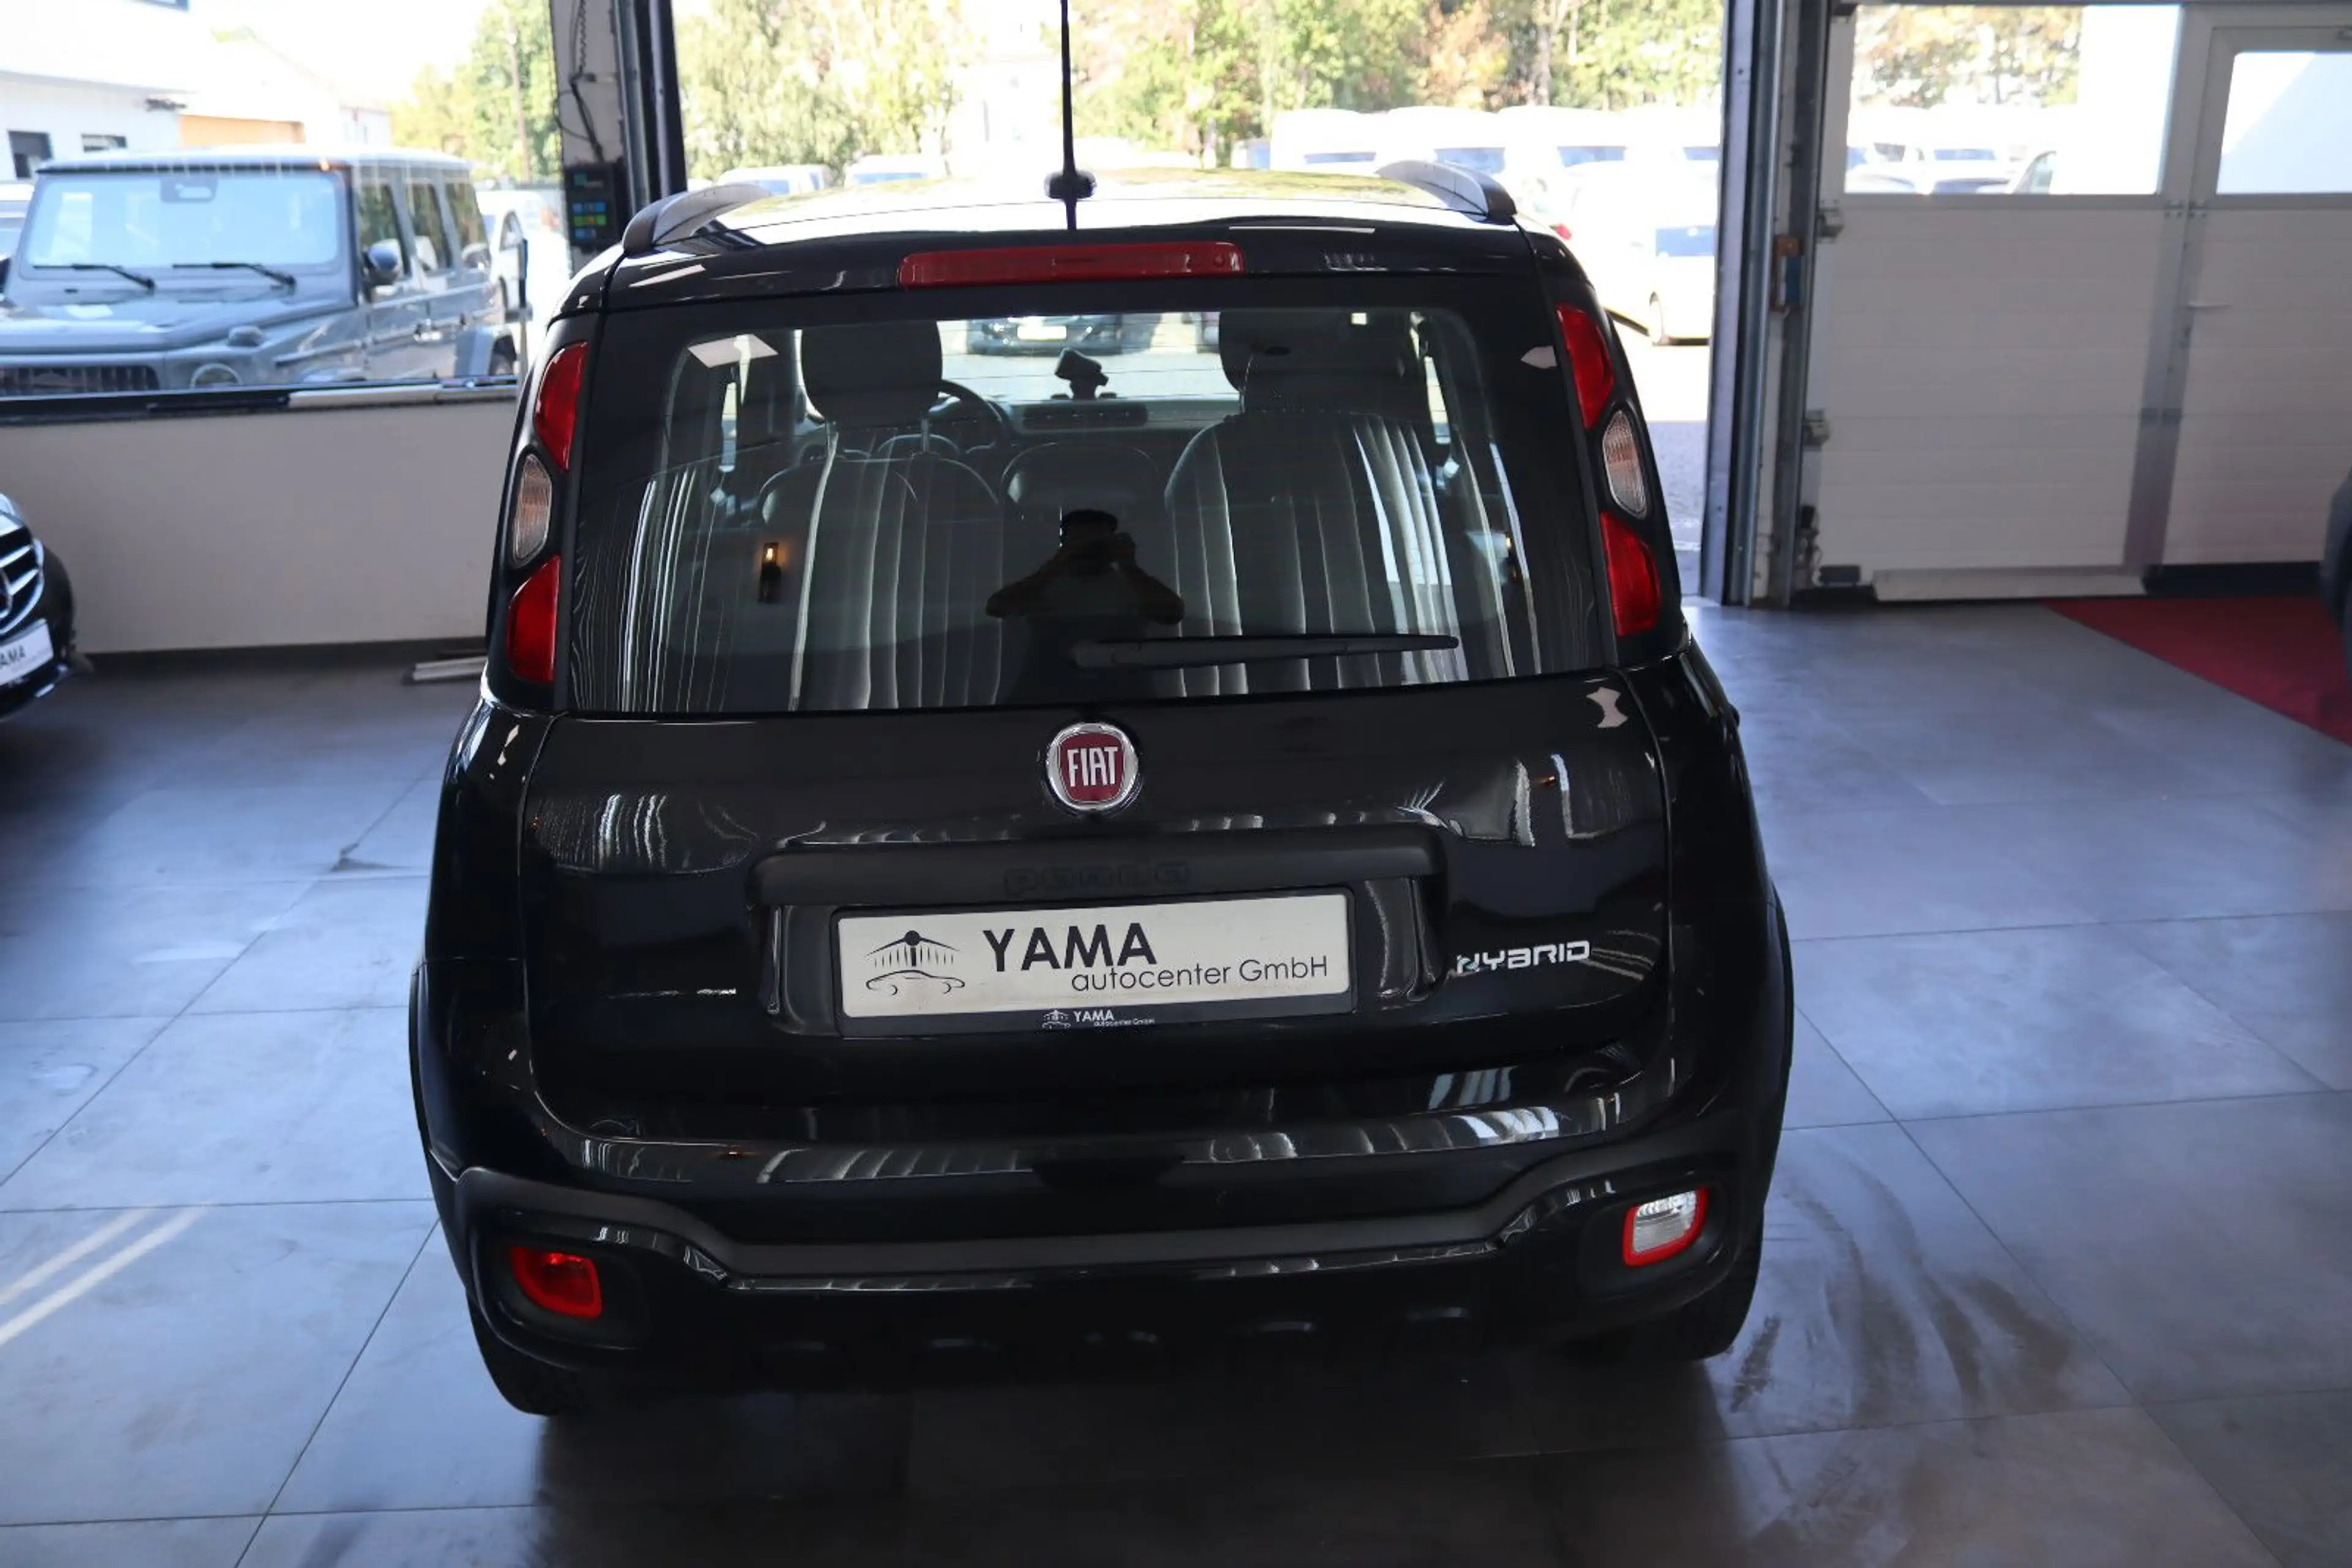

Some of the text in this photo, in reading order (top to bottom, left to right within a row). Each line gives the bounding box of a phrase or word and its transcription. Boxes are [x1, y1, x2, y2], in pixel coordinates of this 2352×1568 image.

[1067, 746, 1118, 787] FIAT
[982, 922, 1158, 972] YAMA
[1457, 940, 1590, 974] HYBRID
[1071, 955, 1327, 991] autocenter GmbH
[1073, 1009, 1115, 1022] YAMA
